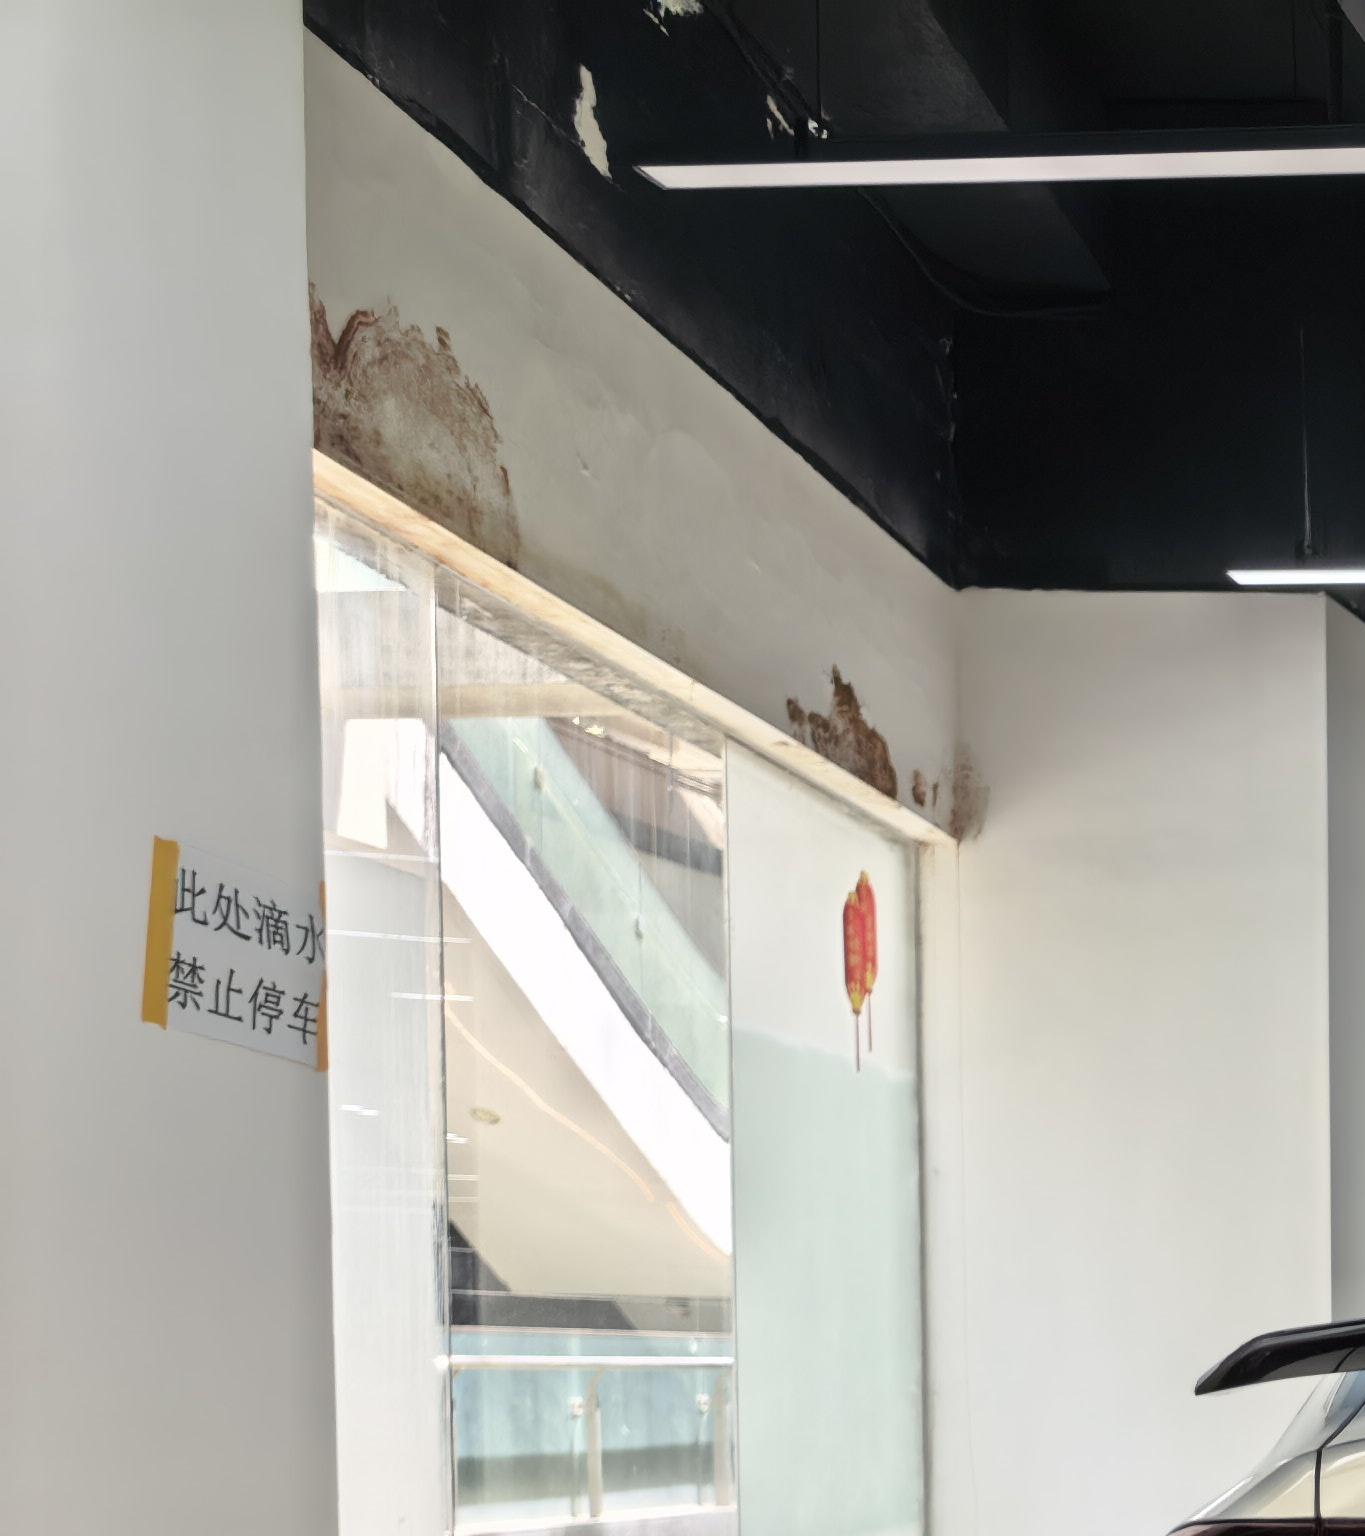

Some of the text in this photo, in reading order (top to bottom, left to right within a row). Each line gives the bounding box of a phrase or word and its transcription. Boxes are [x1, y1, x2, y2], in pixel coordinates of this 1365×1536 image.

[174, 867, 326, 965] 此处滴水
[167, 951, 320, 1045] 禁止停车
